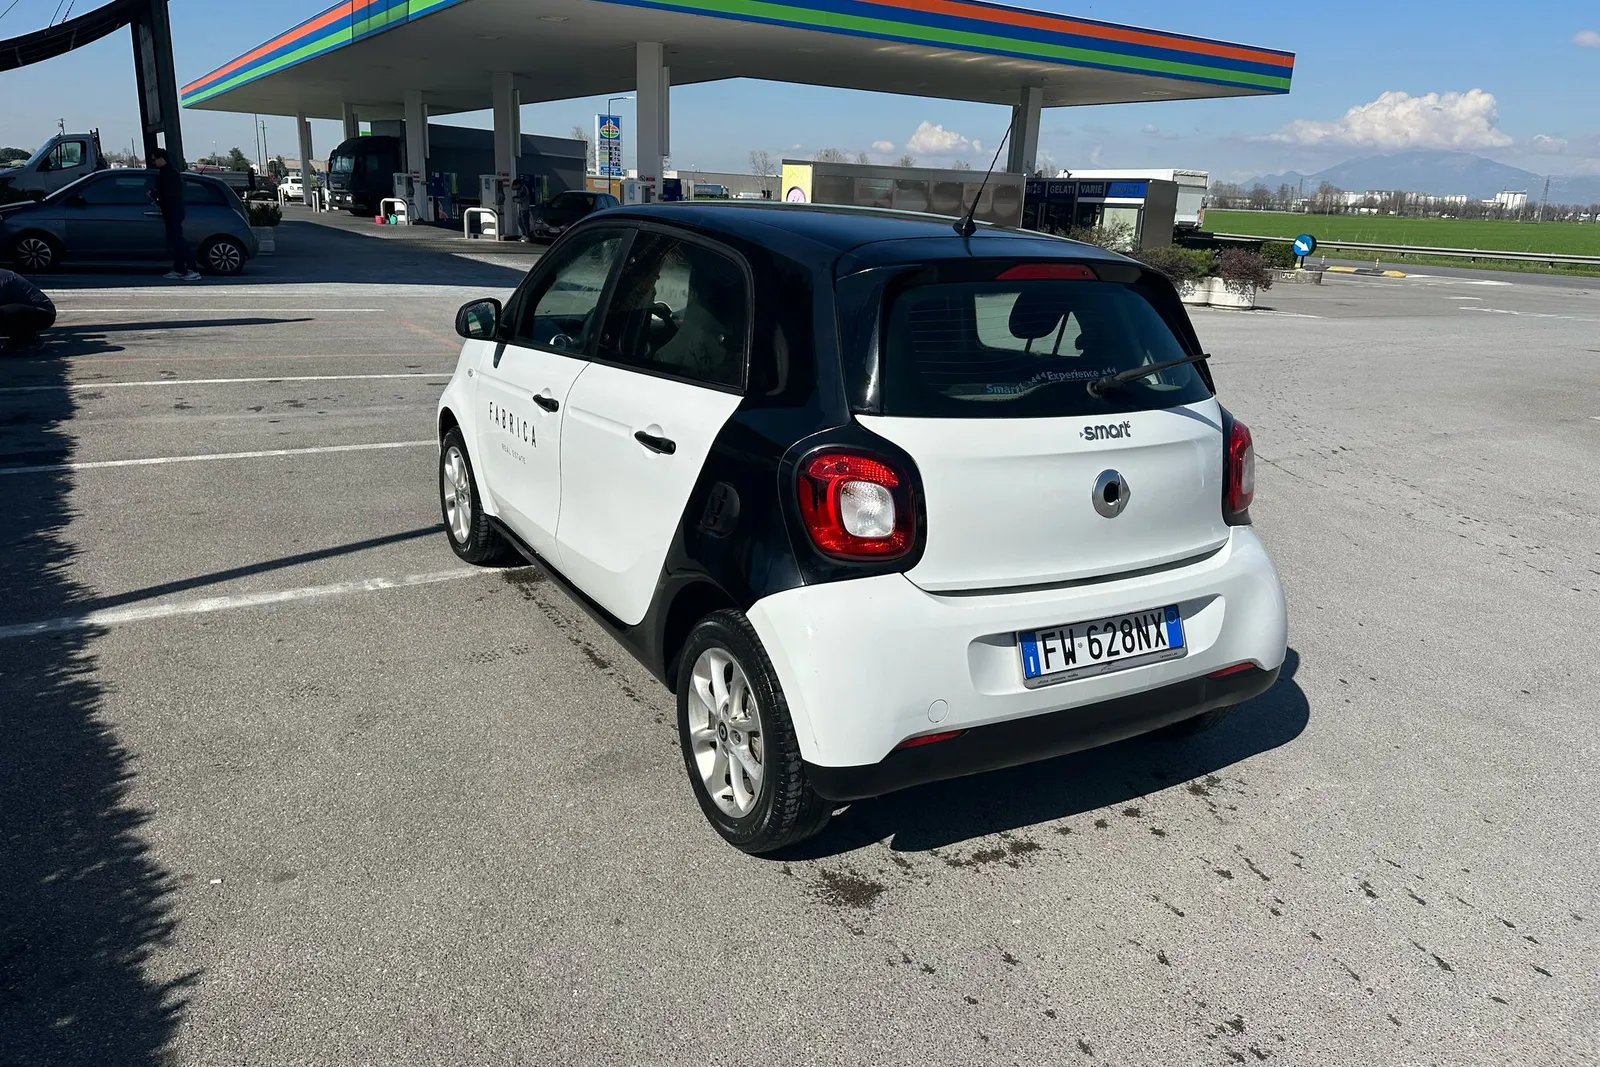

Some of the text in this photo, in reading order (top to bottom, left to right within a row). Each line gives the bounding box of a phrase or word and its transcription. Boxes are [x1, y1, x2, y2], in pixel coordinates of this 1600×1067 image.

[1049, 185, 1075, 194] GELATI
[1080, 184, 1103, 194] VARIE
[1047, 369, 1099, 382] Experience
[490, 402, 537, 448] FABRICA
[1083, 420, 1131, 441] smart
[1041, 611, 1167, 669] FW 628NX
